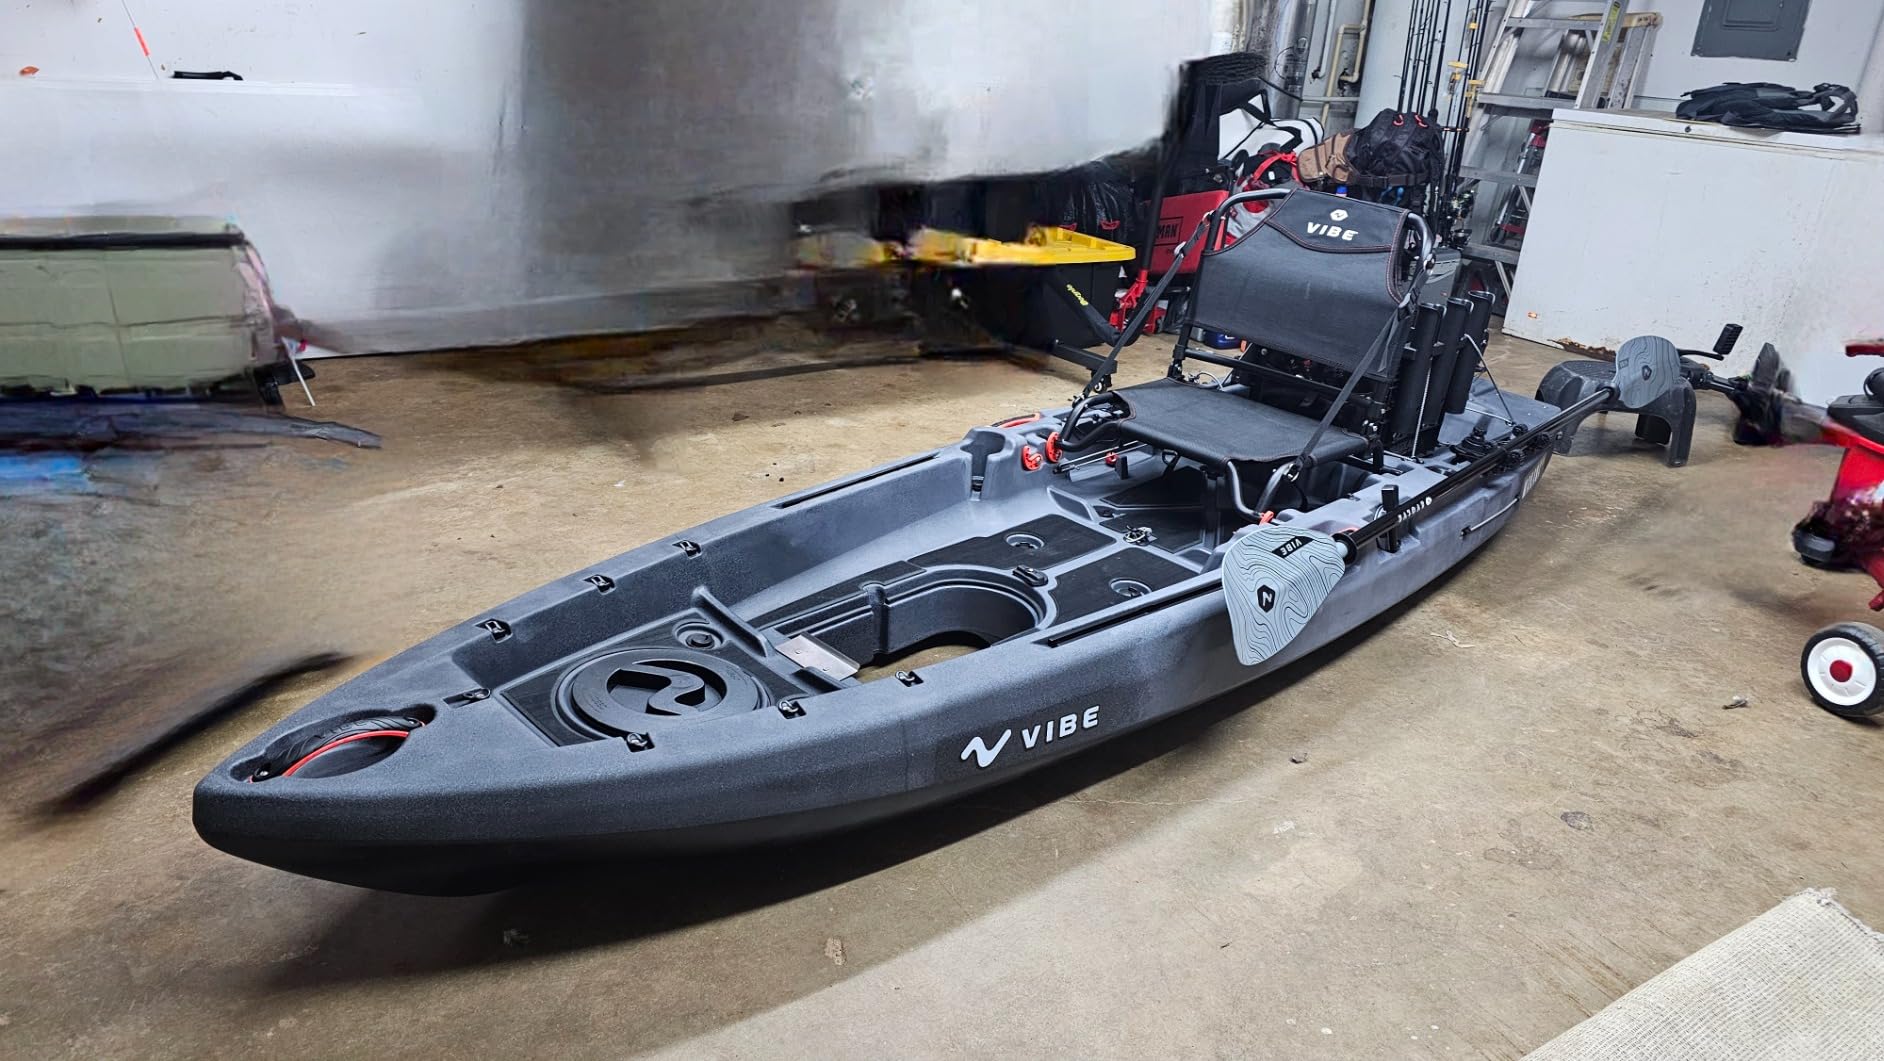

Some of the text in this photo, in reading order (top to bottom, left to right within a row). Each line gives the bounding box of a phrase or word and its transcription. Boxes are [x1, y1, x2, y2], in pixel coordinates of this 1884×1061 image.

[1307, 222, 1359, 241] VIBE
[1281, 538, 1303, 556] VIBE
[1021, 705, 1100, 749] VIBE
